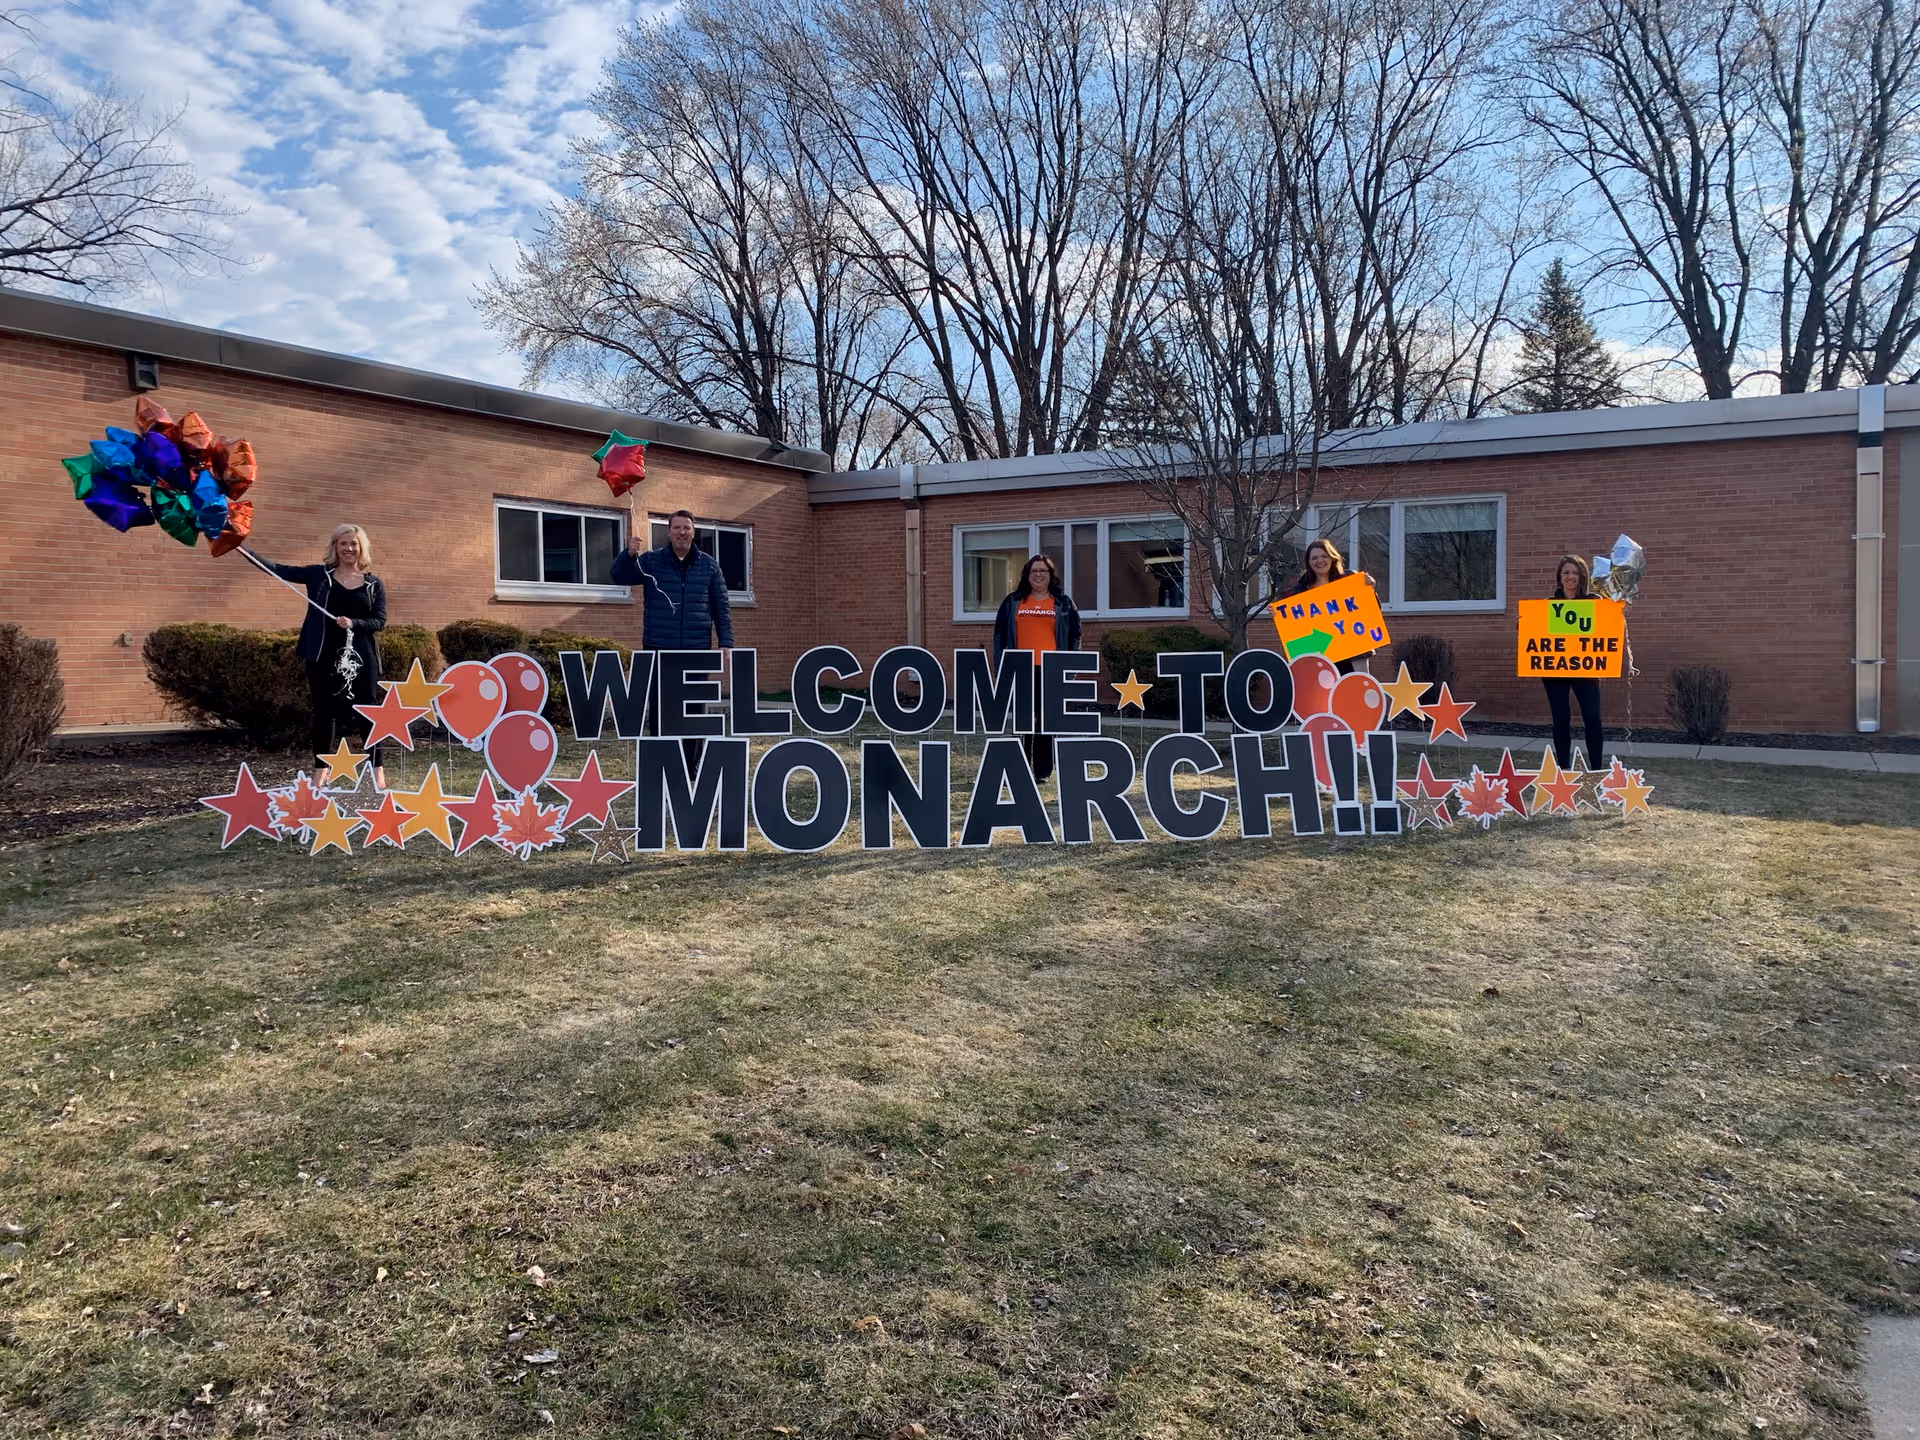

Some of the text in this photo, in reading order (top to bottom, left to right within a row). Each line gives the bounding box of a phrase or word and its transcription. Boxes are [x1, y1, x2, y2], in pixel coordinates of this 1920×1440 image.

[1277, 597, 1359, 620] THANK
[1552, 603, 1592, 632] YOU
[1333, 619, 1383, 642] YOU
[1526, 637, 1619, 653] ARE THE
[1530, 656, 1607, 671] REASON
[559, 645, 1295, 740] WELCOME TO
[635, 731, 1401, 853] MONARCH!!
